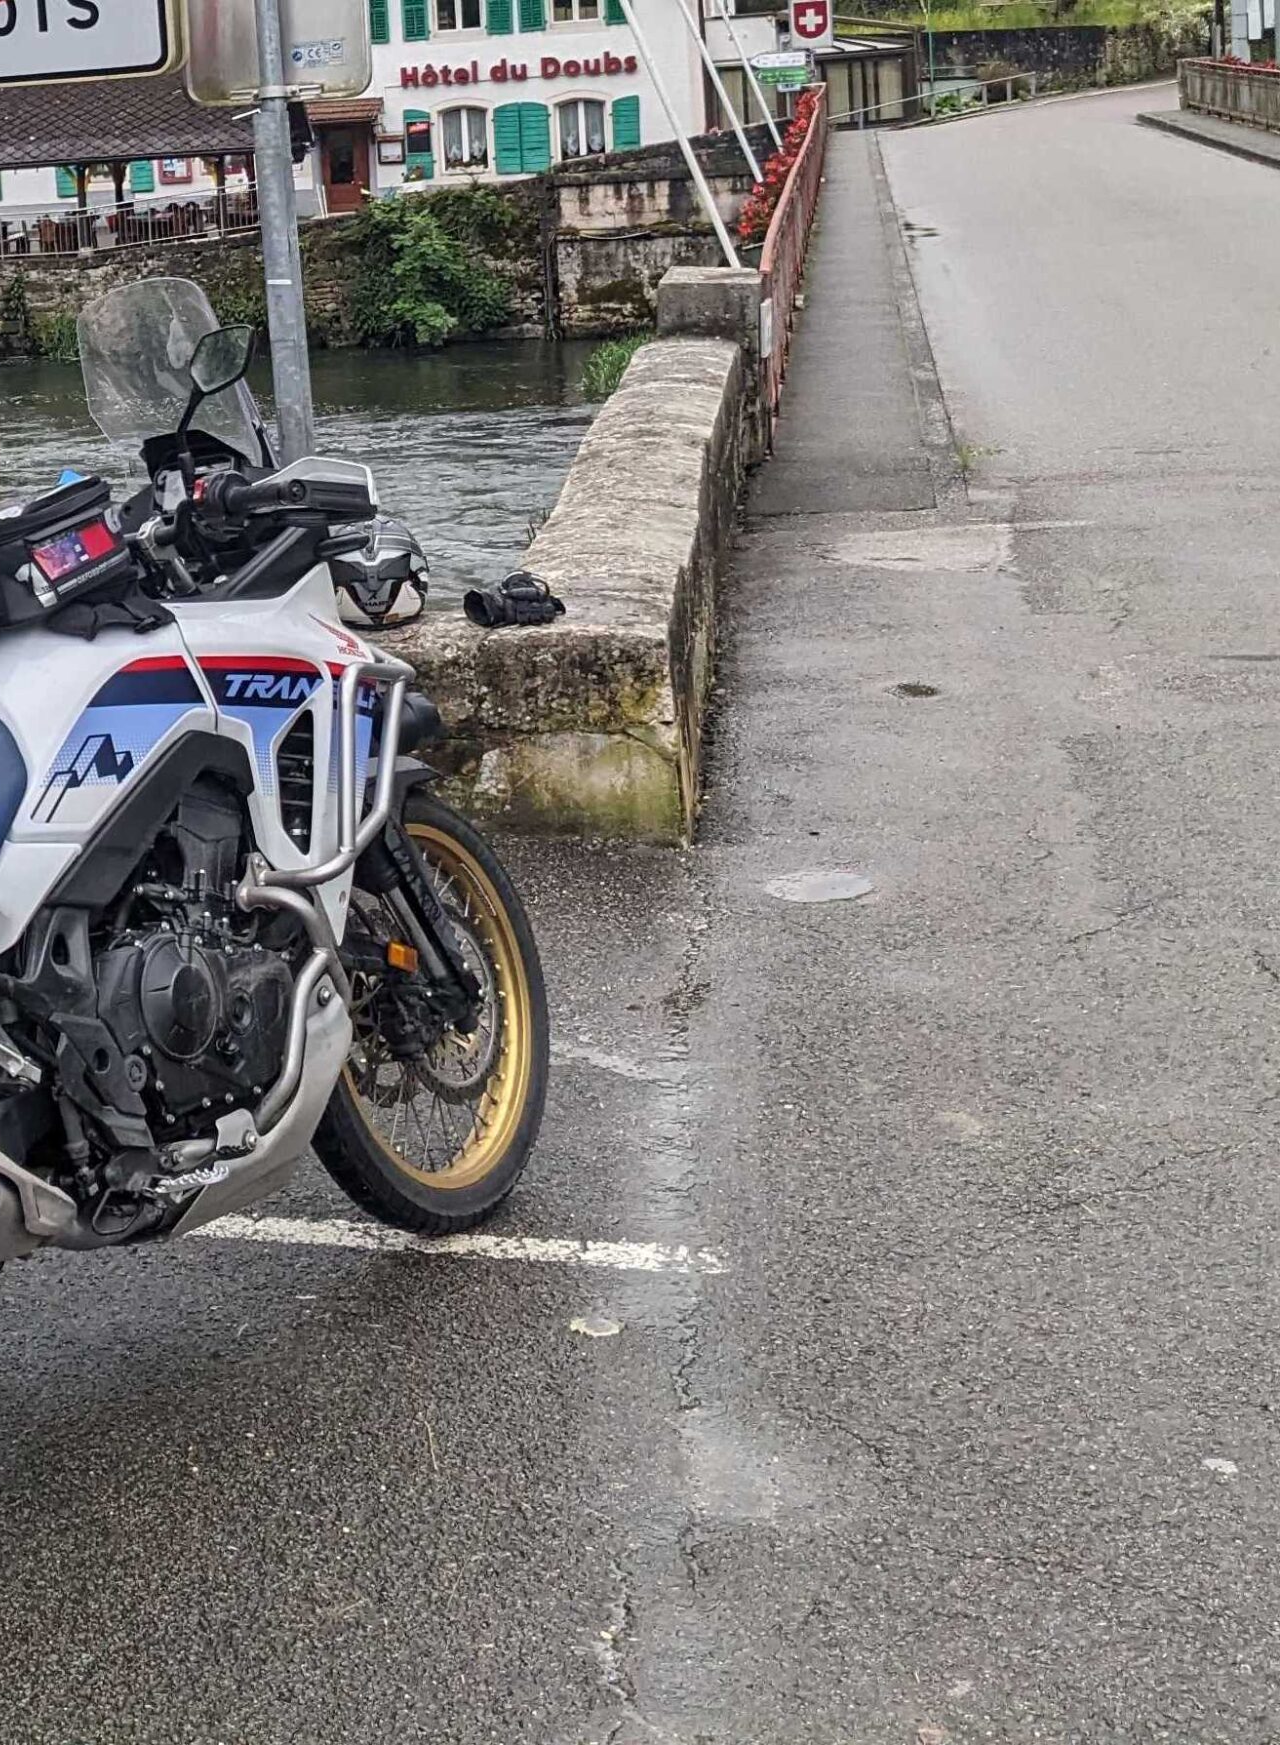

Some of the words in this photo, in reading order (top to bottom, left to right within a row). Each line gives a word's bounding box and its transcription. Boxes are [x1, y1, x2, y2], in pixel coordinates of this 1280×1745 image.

[400, 61, 480, 88] Hôtel
[490, 59, 527, 82] du
[540, 52, 638, 80] Doubs
